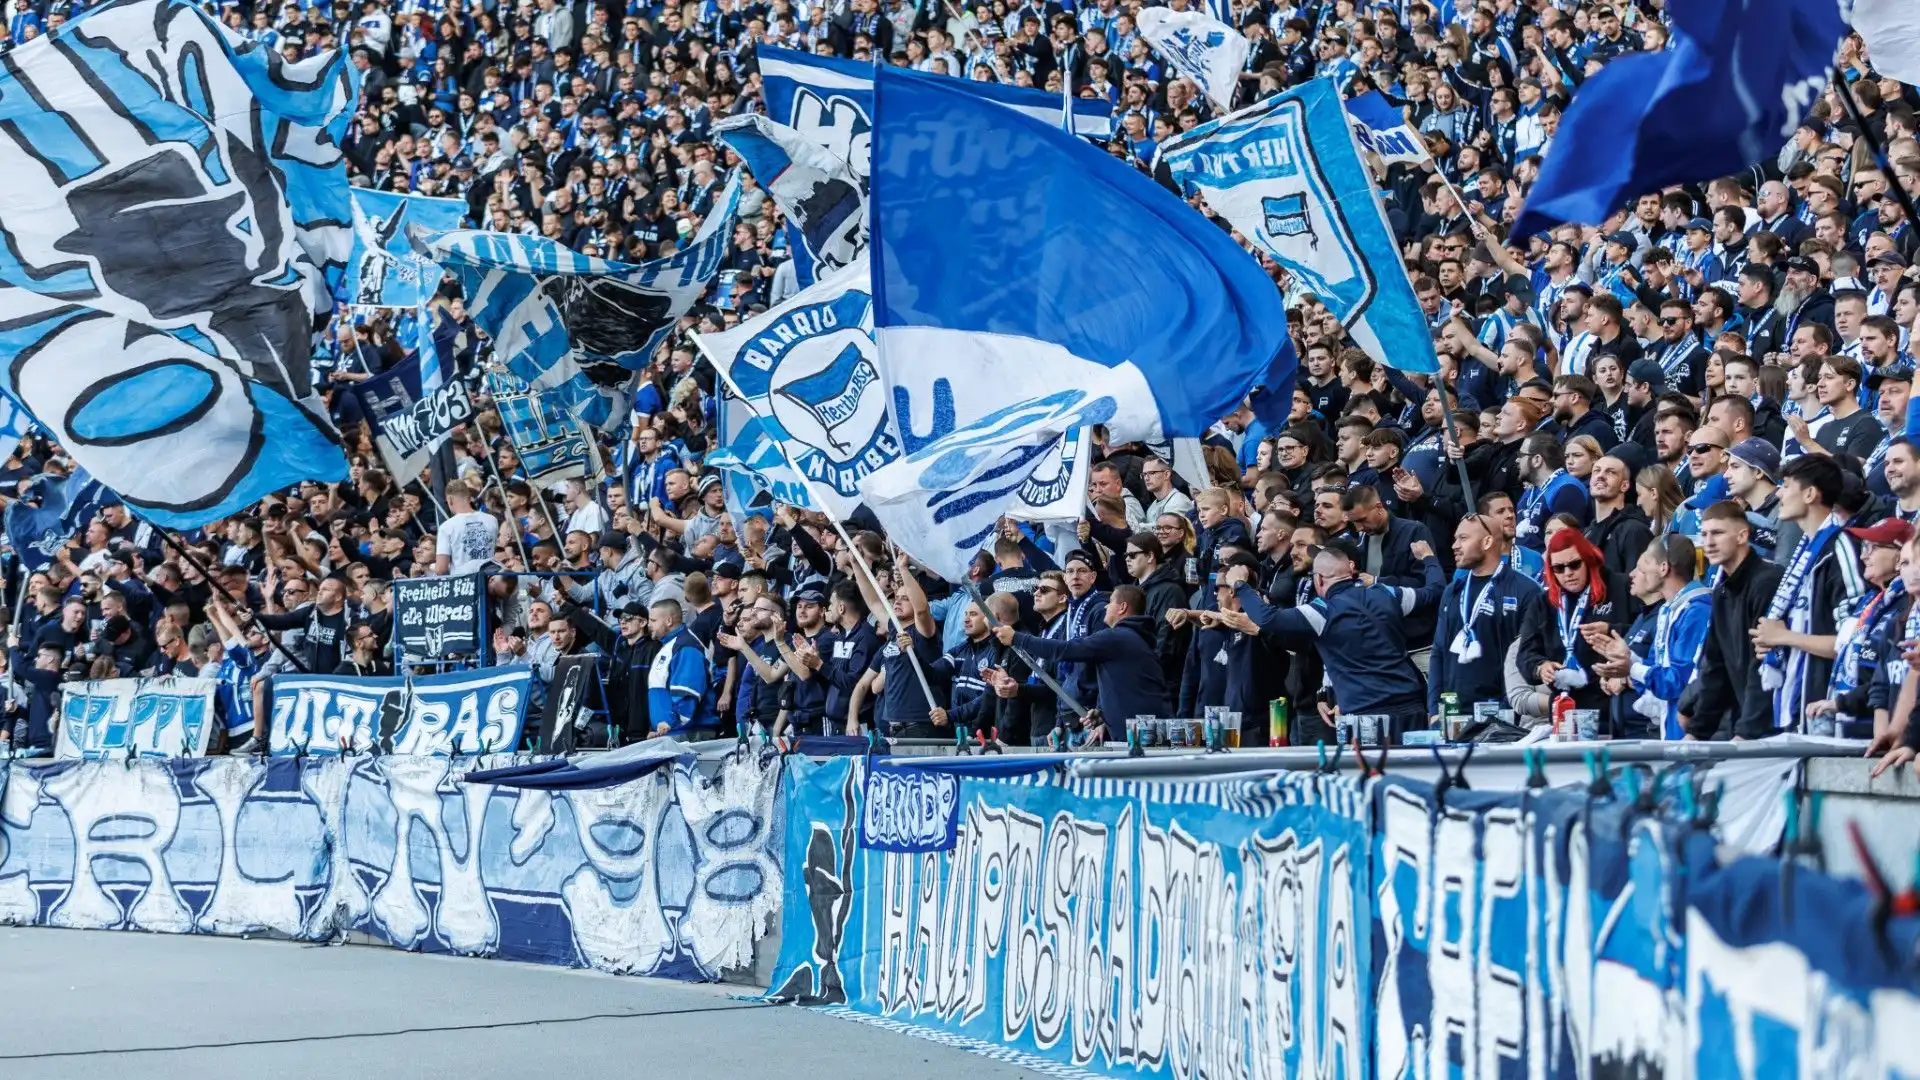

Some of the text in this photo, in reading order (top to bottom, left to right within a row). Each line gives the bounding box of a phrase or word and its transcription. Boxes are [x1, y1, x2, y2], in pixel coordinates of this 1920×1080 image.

[743, 305, 837, 372] BARRIO
[807, 421, 898, 494] NORDBE
[398, 582, 450, 602] Freiheit
[269, 686, 521, 755] ULTRAS
